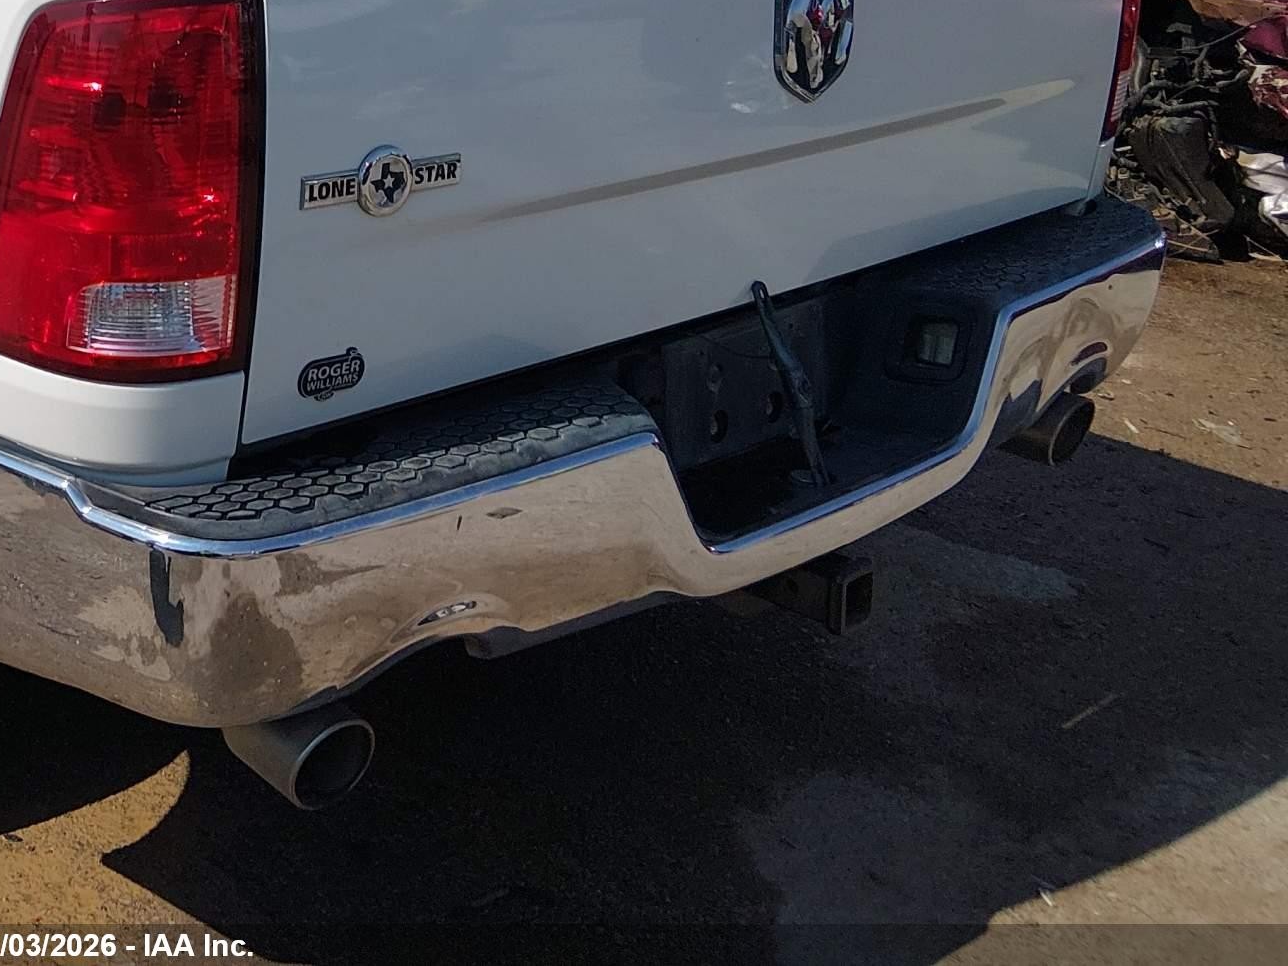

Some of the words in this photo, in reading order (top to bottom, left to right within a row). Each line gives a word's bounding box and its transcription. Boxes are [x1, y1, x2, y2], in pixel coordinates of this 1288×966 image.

[308, 178, 357, 203] LONE
[414, 161, 459, 184] STAR
[308, 360, 360, 381] ROGER
[306, 372, 359, 392] WILLIAMS
